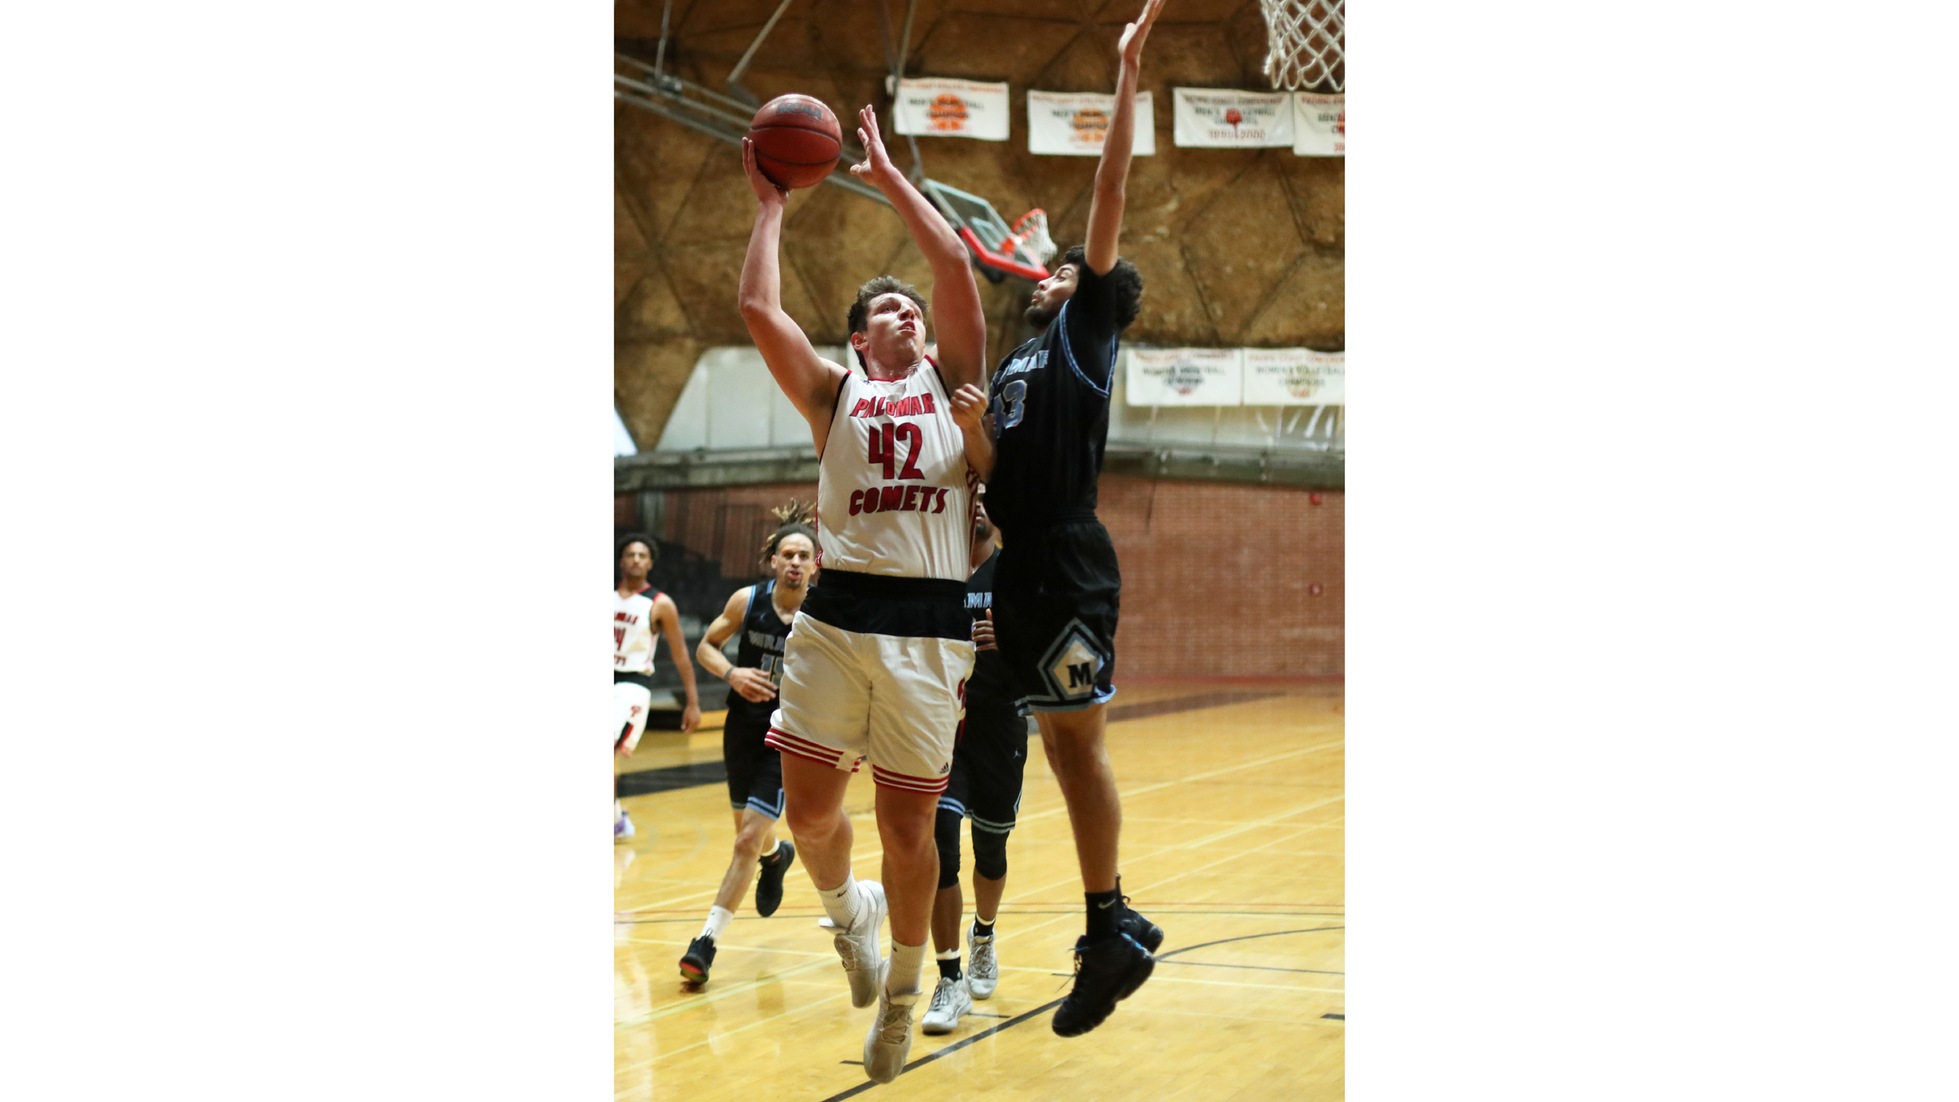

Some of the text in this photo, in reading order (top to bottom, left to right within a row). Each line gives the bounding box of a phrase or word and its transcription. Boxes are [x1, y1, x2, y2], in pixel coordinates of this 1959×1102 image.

[849, 392, 935, 418] PALOMAR
[868, 422, 926, 480] 42
[848, 485, 949, 517] COMETS
[1066, 661, 1093, 689] M
